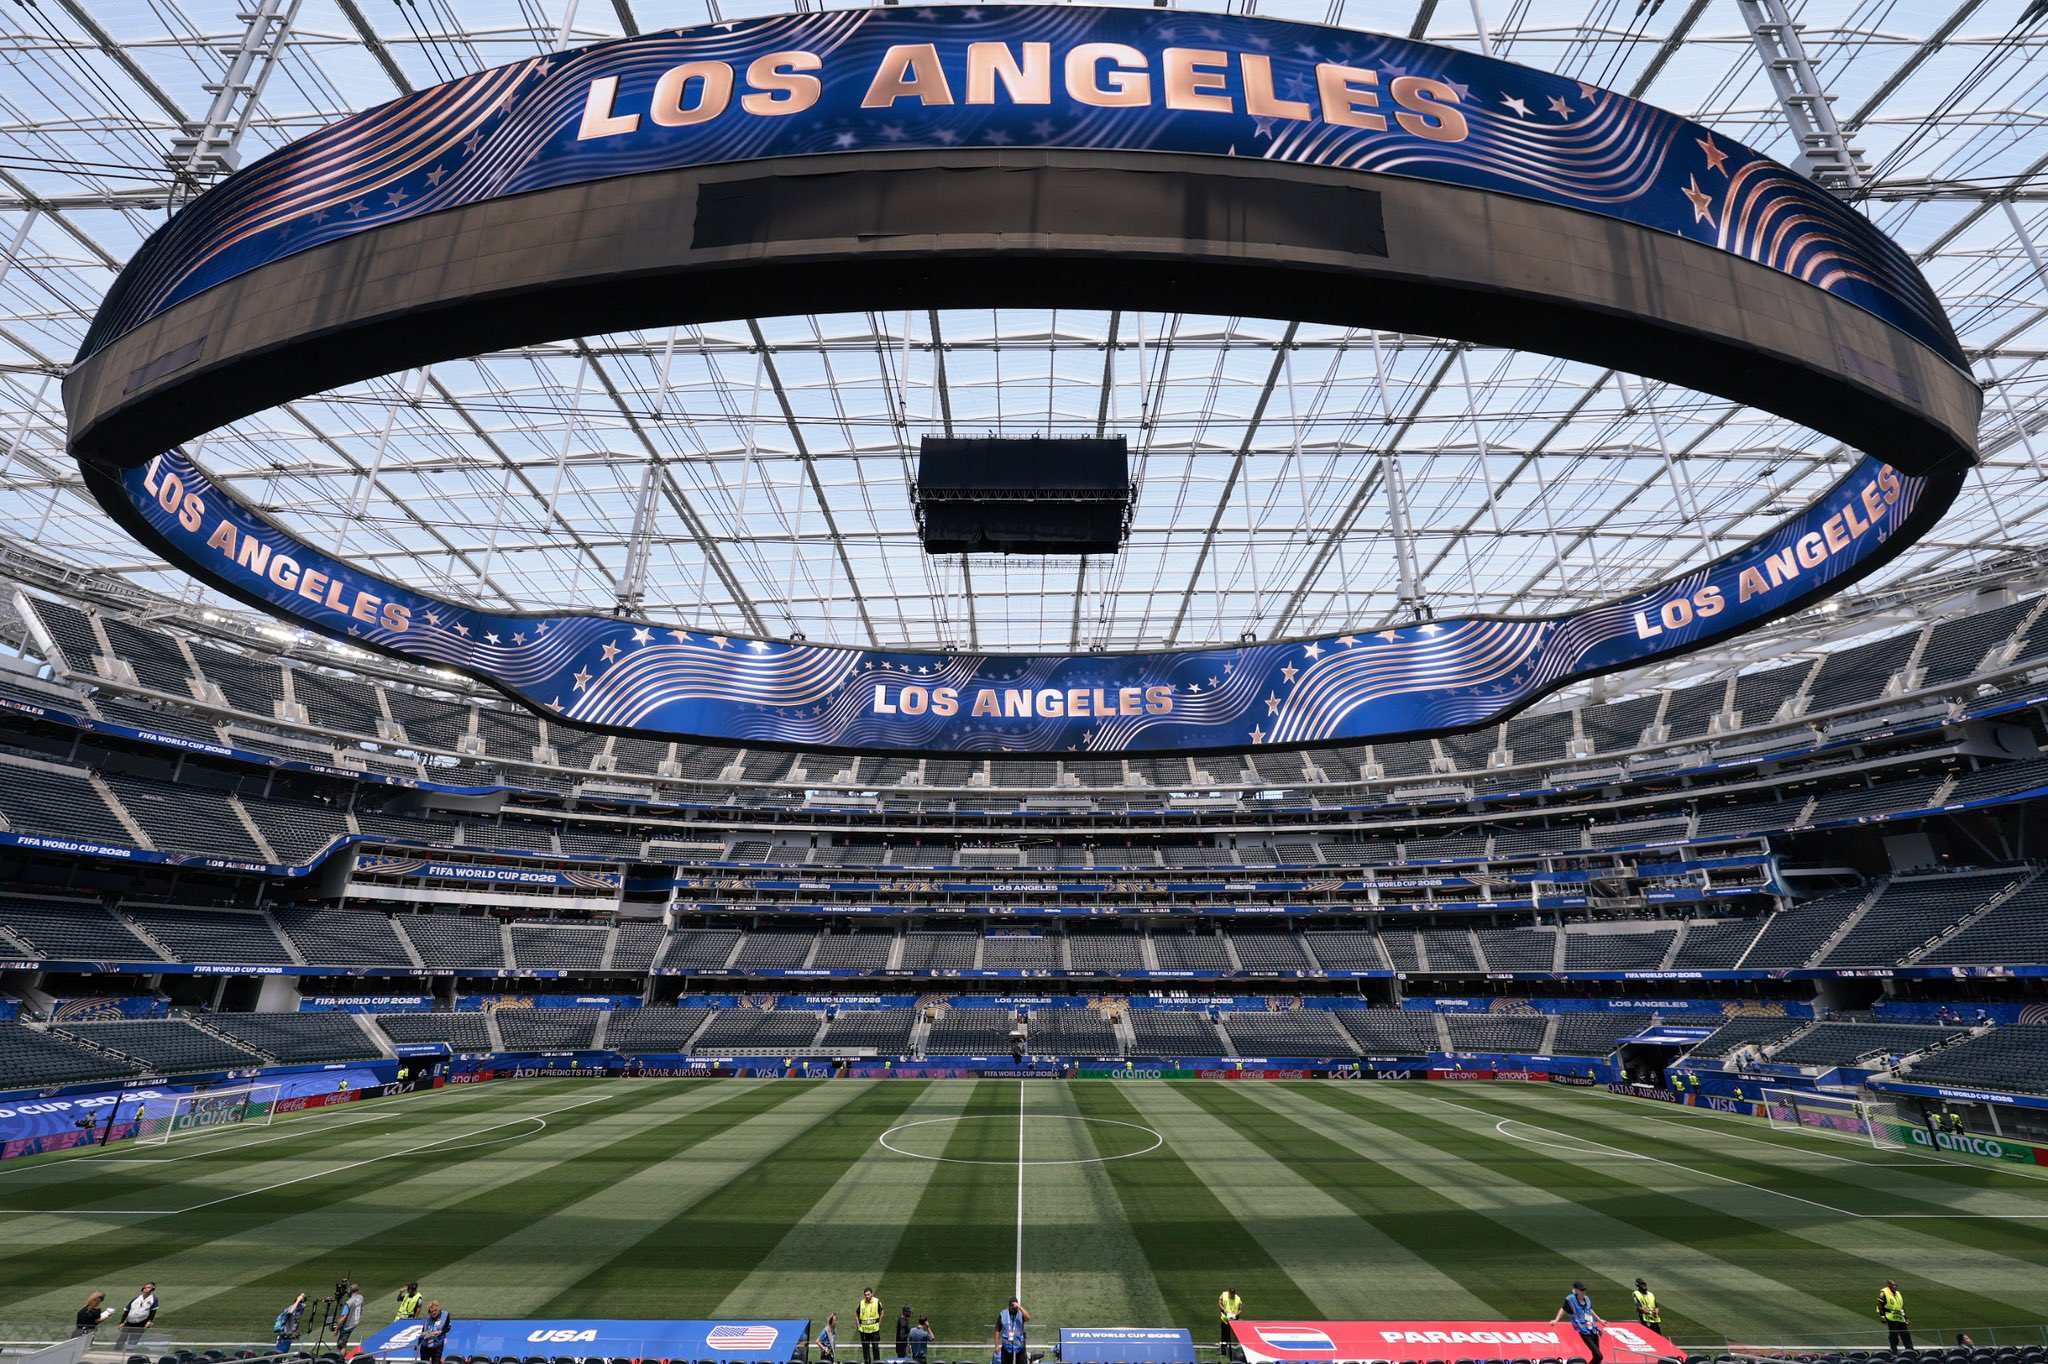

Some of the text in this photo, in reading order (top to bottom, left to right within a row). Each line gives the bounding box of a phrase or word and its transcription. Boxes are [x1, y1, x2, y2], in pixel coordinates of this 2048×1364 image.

[577, 41, 1469, 143] LOS ANGELES
[143, 455, 412, 633] LOS ANGELES
[1634, 463, 1900, 640] LOS ANGELES
[873, 684, 1174, 717] LOS ANGELES
[138, 732, 232, 755] FIFA WORLD CUP 2026
[18, 836, 130, 857] FIFA WORLD CUP 2026
[429, 866, 556, 883] FIFA WORLD CUP 2026
[513, 1068, 538, 1077] ADI
[638, 1069, 669, 1078] QATAR
[755, 1069, 778, 1078] VISA
[805, 1069, 828, 1078] VISA
[1112, 1069, 1161, 1078] aramco
[1201, 1070, 1225, 1079] Coca-Cola
[1240, 1070, 1264, 1079] Coca-Cola
[1279, 1070, 1303, 1079] Coca-Cola
[1328, 1070, 1361, 1079] KIA
[1377, 1070, 1410, 1079] KIA
[383, 1082, 415, 1096] KIA
[1607, 1083, 1676, 1102] QATAR AIRWAYS
[17, 1102, 72, 1115] CUP
[74, 1090, 163, 1108] 2026
[276, 1098, 307, 1113] Coca-Cola
[324, 1092, 352, 1106] Coca-Cola
[1707, 1097, 1737, 1113] VISA
[180, 1108, 236, 1129] aramc
[1912, 1129, 2002, 1158] aramco
[527, 1329, 598, 1343] USA
[1380, 1331, 1560, 1344] PARAGUAY
